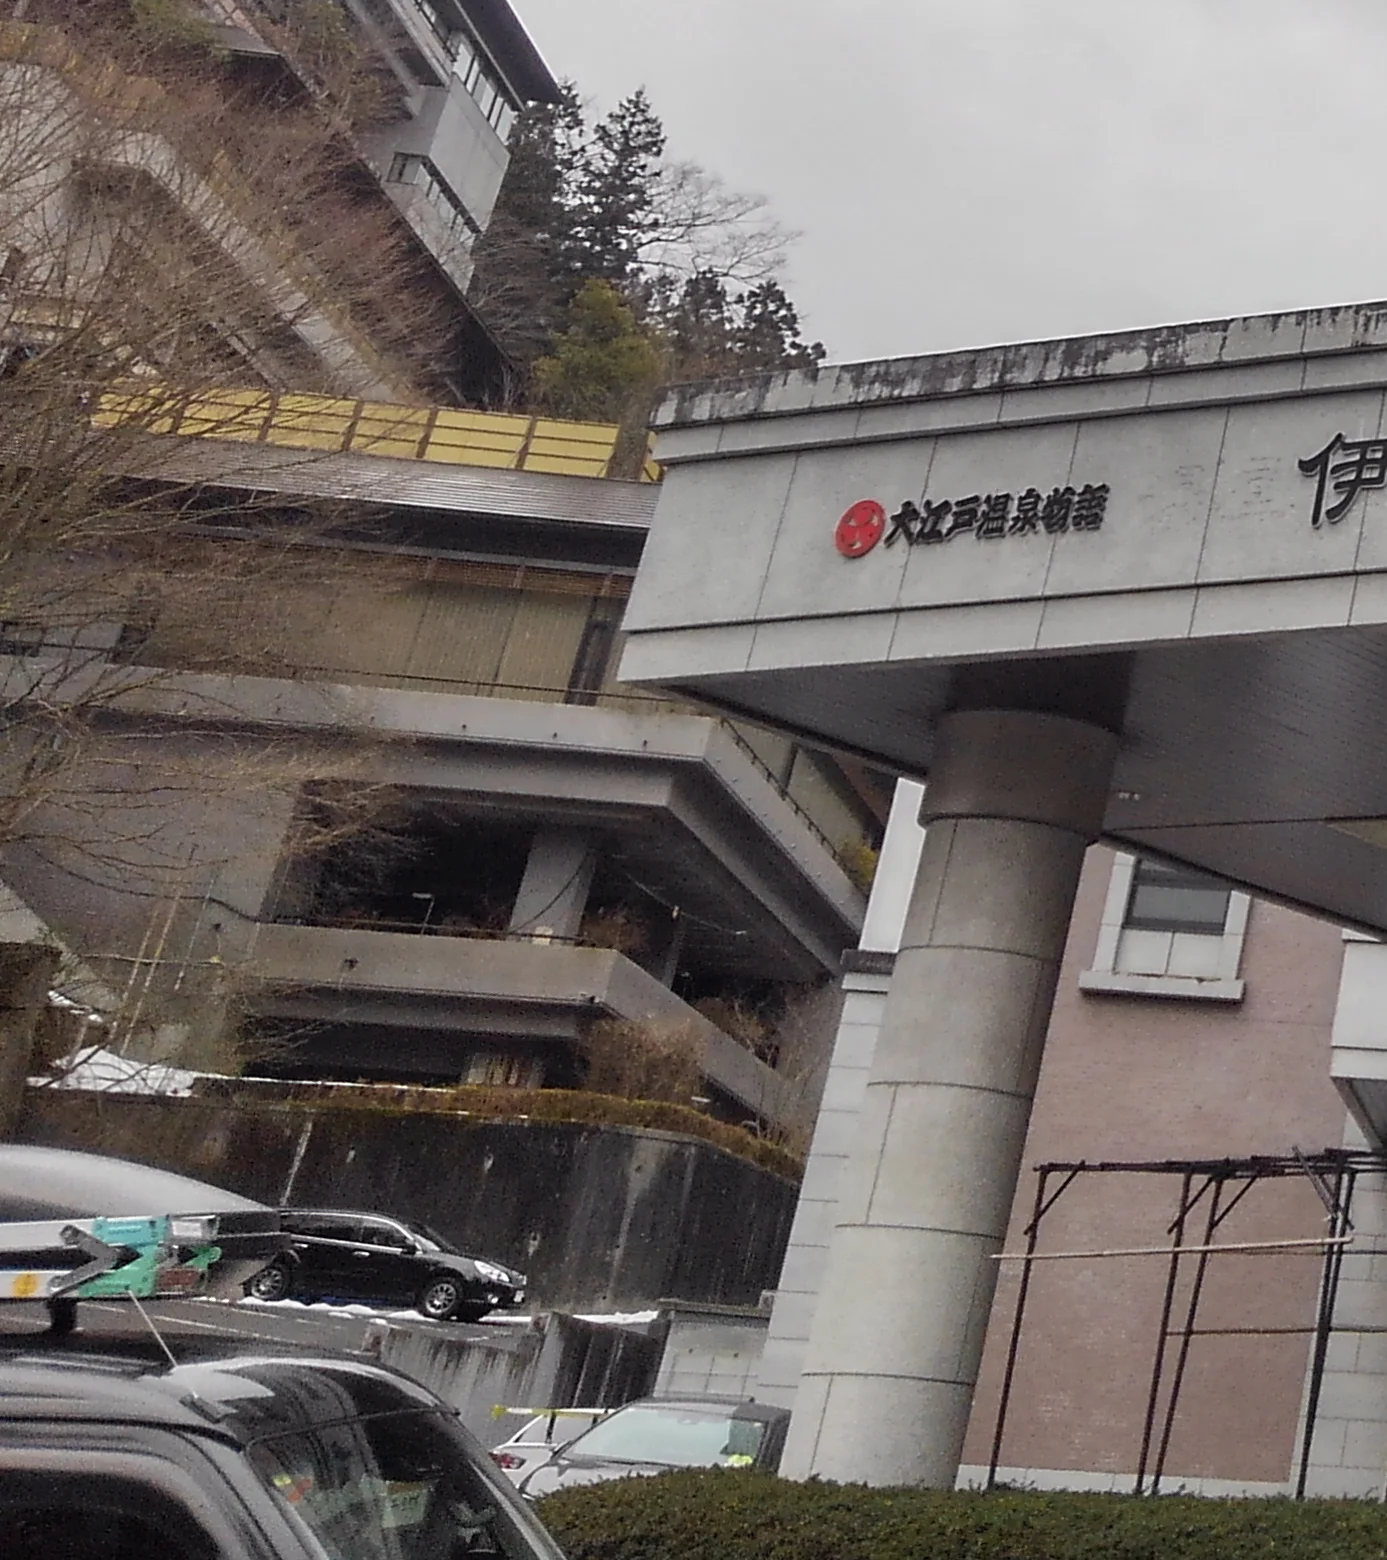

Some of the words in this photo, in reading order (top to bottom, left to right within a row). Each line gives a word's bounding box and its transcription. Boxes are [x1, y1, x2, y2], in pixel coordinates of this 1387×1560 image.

[884, 483, 1110, 548] 大江戸温泉物語
